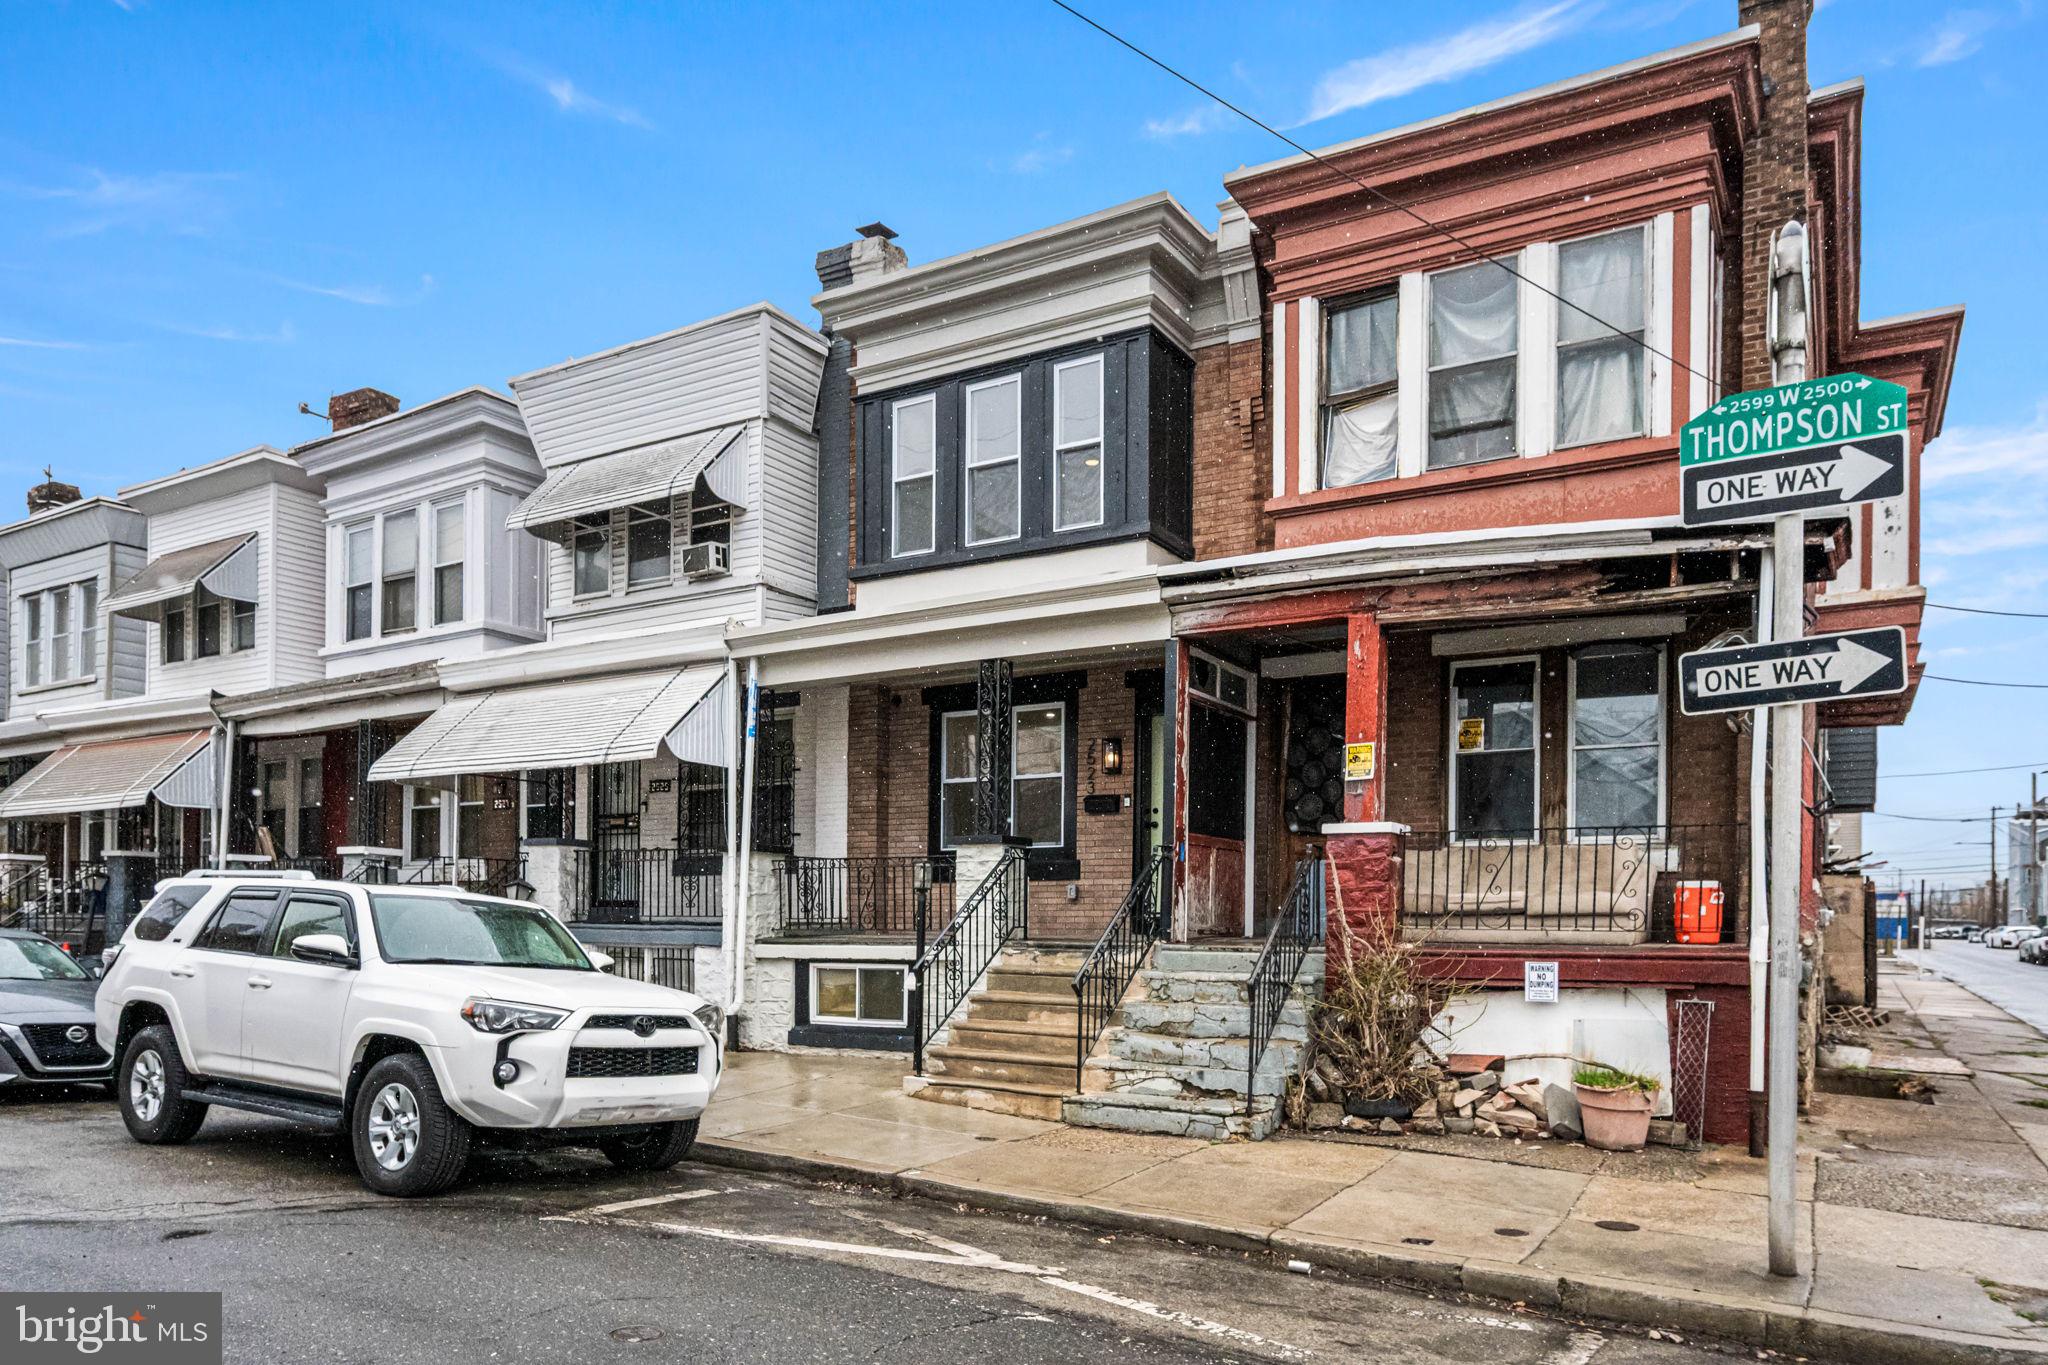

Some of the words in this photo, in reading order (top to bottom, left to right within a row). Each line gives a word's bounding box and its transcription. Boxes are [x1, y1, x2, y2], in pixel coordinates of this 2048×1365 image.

[1729, 394, 1775, 414] 2599
[1779, 387, 1800, 406] W
[1803, 380, 1854, 401] 2500
[1689, 398, 1863, 460] THOMPSON
[1877, 402, 1902, 430] ST
[1707, 475, 1764, 504] ONE
[1775, 463, 1836, 494] WAY
[1705, 665, 1761, 693] ONE
[1772, 656, 1833, 684] WAY
[1086, 737, 1097, 794] 2523
[1529, 980, 1554, 988] DUMPING
[1537, 972, 1547, 980] NO
